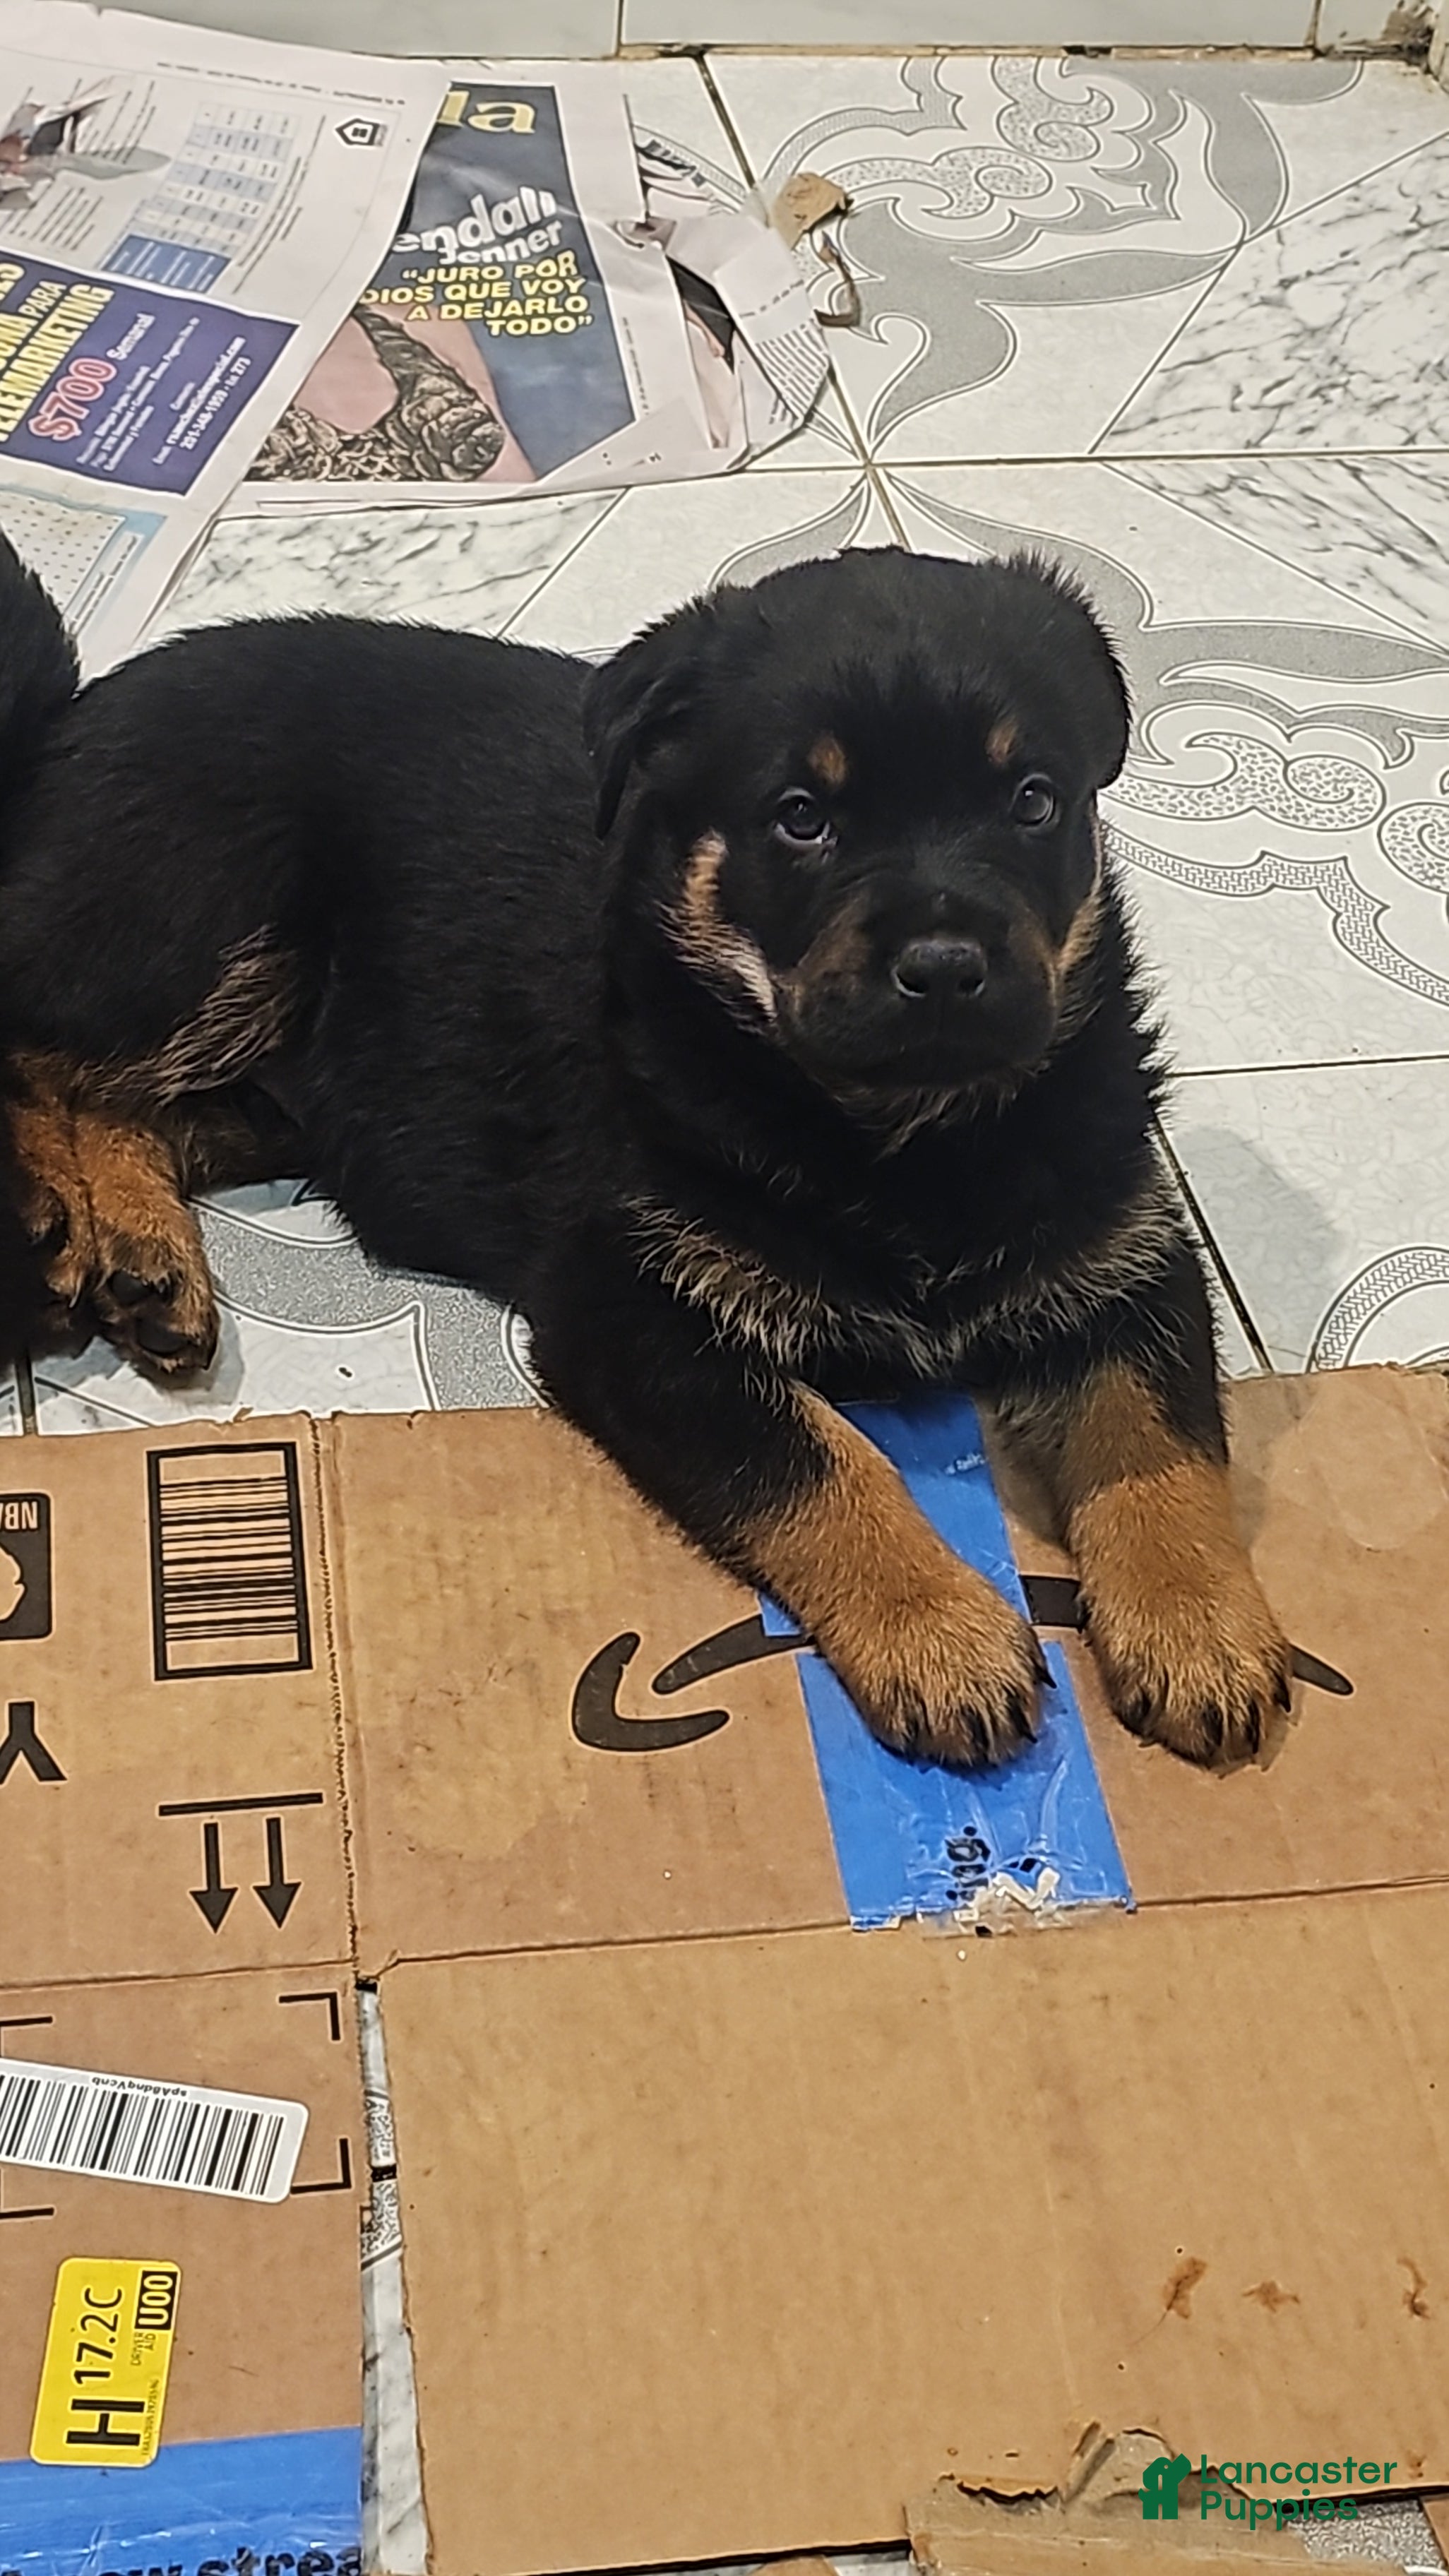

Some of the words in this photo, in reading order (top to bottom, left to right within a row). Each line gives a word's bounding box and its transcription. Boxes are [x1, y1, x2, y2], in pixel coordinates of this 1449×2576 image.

[515, 250, 578, 278] POR
[18, 280, 66, 318] PARA
[444, 281, 512, 302] QUE
[522, 278, 585, 296] VOY
[407, 306, 429, 321] A
[440, 295, 588, 319] DEJARLO
[0, 284, 114, 443] LEMARKETING
[28, 357, 117, 441] $700
[106, 313, 155, 361] Semanal
[0, 1501, 37, 1530] NB
[73, 2287, 122, 2385] 17.2C
[131, 2332, 144, 2366] DRIVER
[144, 2333, 156, 2351] AID
[66, 2399, 145, 2445] H
